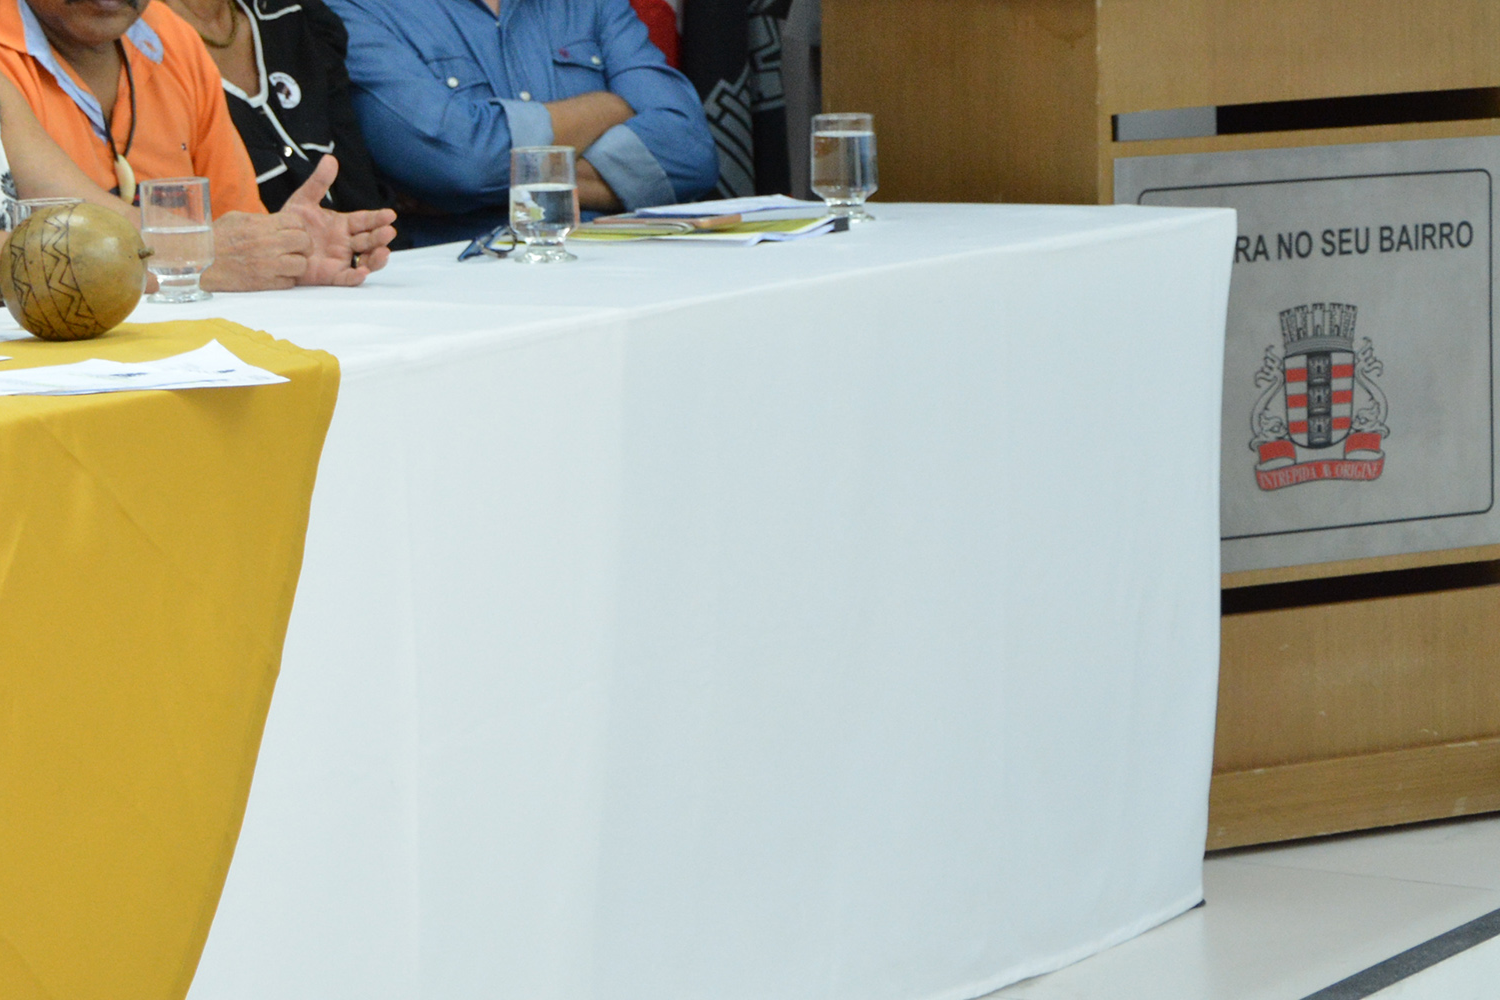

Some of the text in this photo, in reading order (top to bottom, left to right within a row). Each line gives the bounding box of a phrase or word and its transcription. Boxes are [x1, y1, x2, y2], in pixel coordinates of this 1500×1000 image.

[1235, 220, 1474, 263] RA NO SEU BAIRRO
